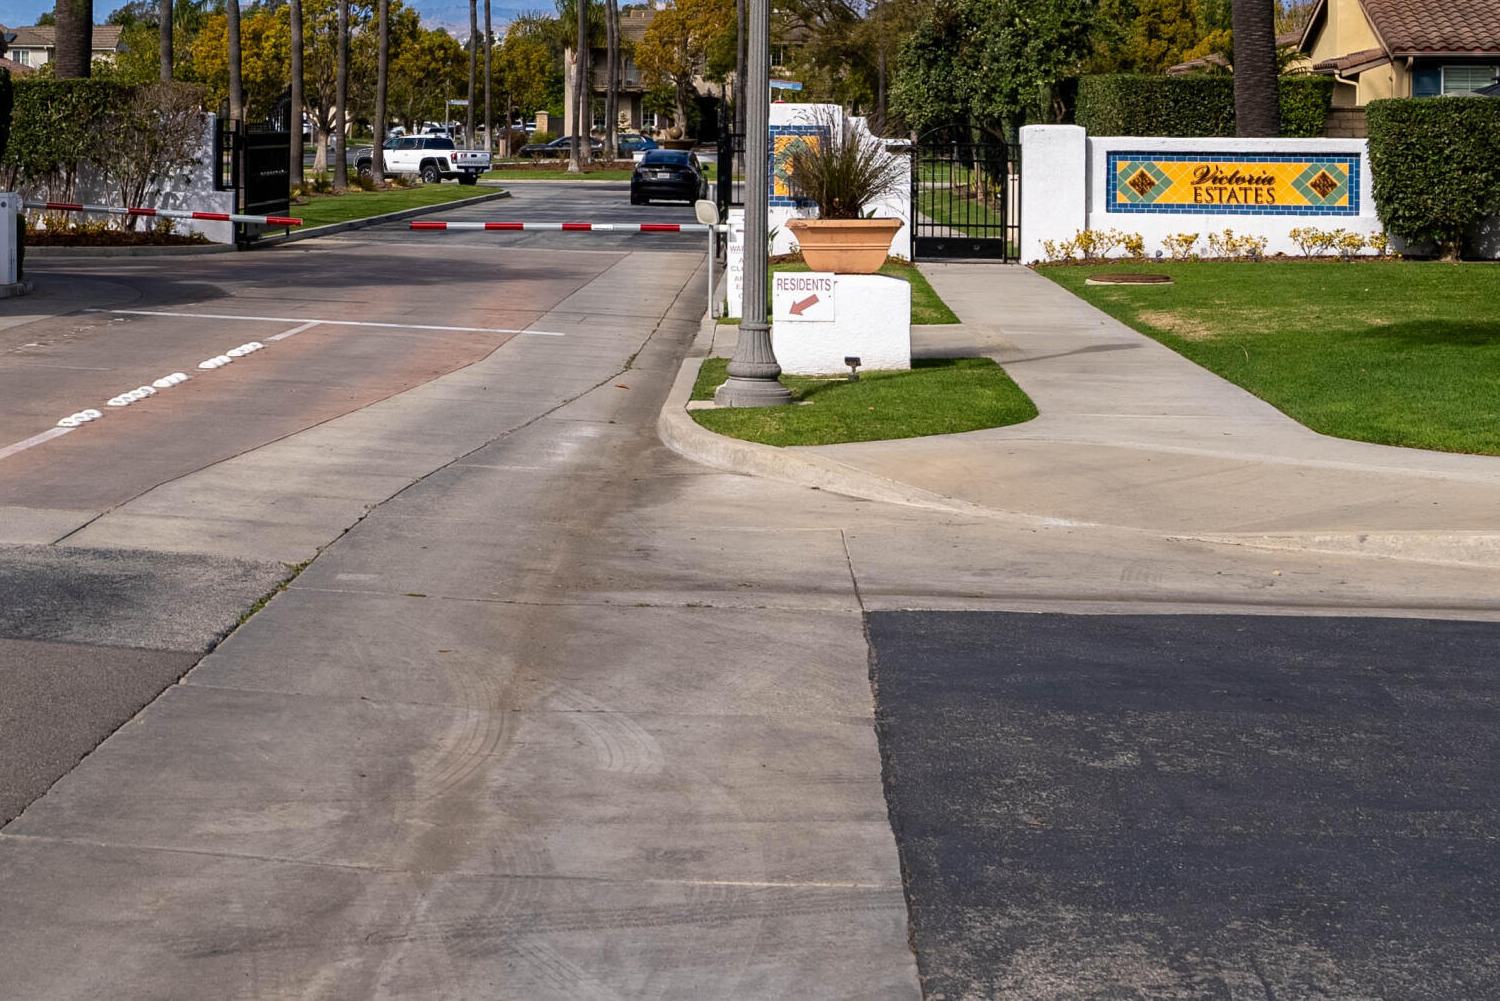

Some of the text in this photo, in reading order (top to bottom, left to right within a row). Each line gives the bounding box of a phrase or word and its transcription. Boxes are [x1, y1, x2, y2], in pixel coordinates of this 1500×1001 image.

[1190, 165, 1276, 186] Victoria
[1193, 187, 1276, 204] ESTATES
[776, 278, 831, 292] RESIDENTS
